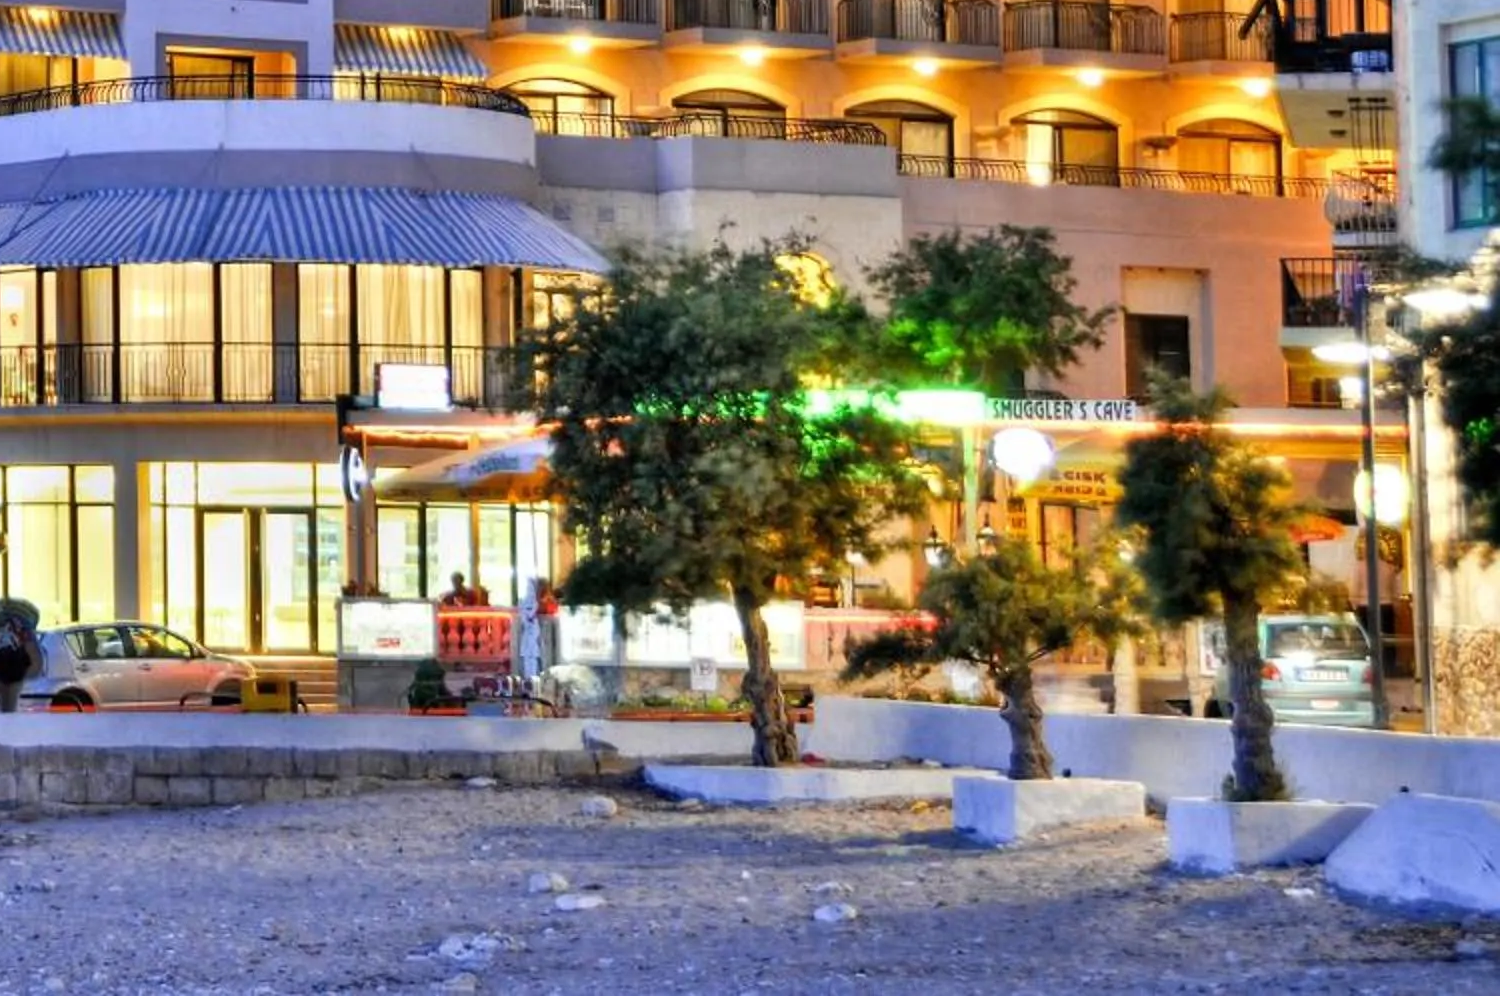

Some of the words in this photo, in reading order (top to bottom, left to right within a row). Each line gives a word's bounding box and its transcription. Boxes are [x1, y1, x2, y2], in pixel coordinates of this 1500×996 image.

[993, 400, 1087, 421] SMUGGLER'S
[1093, 400, 1134, 421] CAVE
[1063, 470, 1106, 484] CISK
